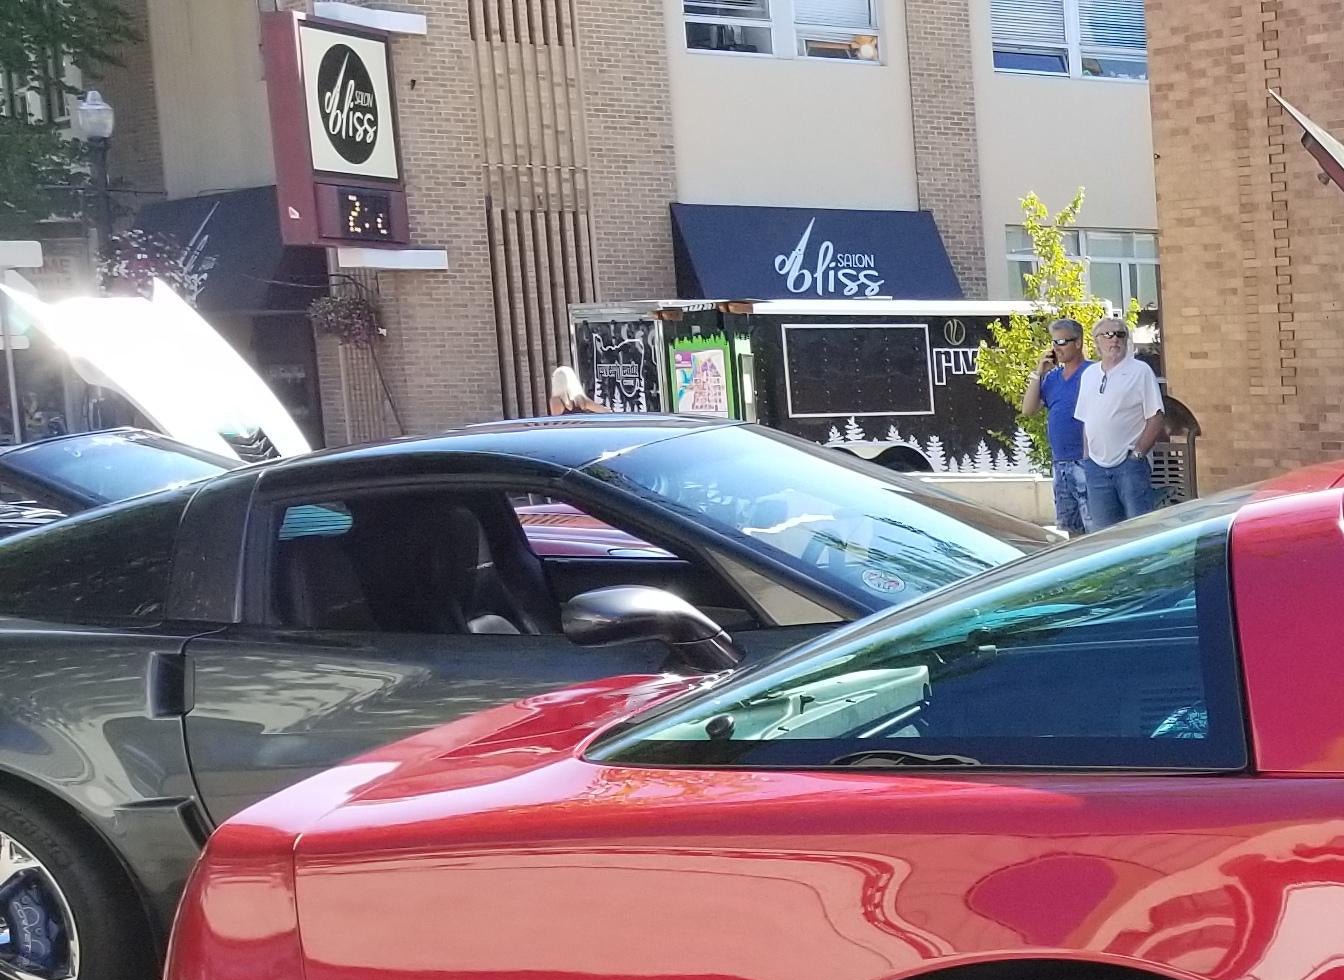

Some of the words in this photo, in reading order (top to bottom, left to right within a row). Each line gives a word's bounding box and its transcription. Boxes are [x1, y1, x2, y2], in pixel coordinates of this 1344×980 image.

[325, 51, 377, 144] bliss
[354, 90, 373, 108] SALON
[774, 216, 885, 297] bliss
[837, 253, 875, 268] SALON
